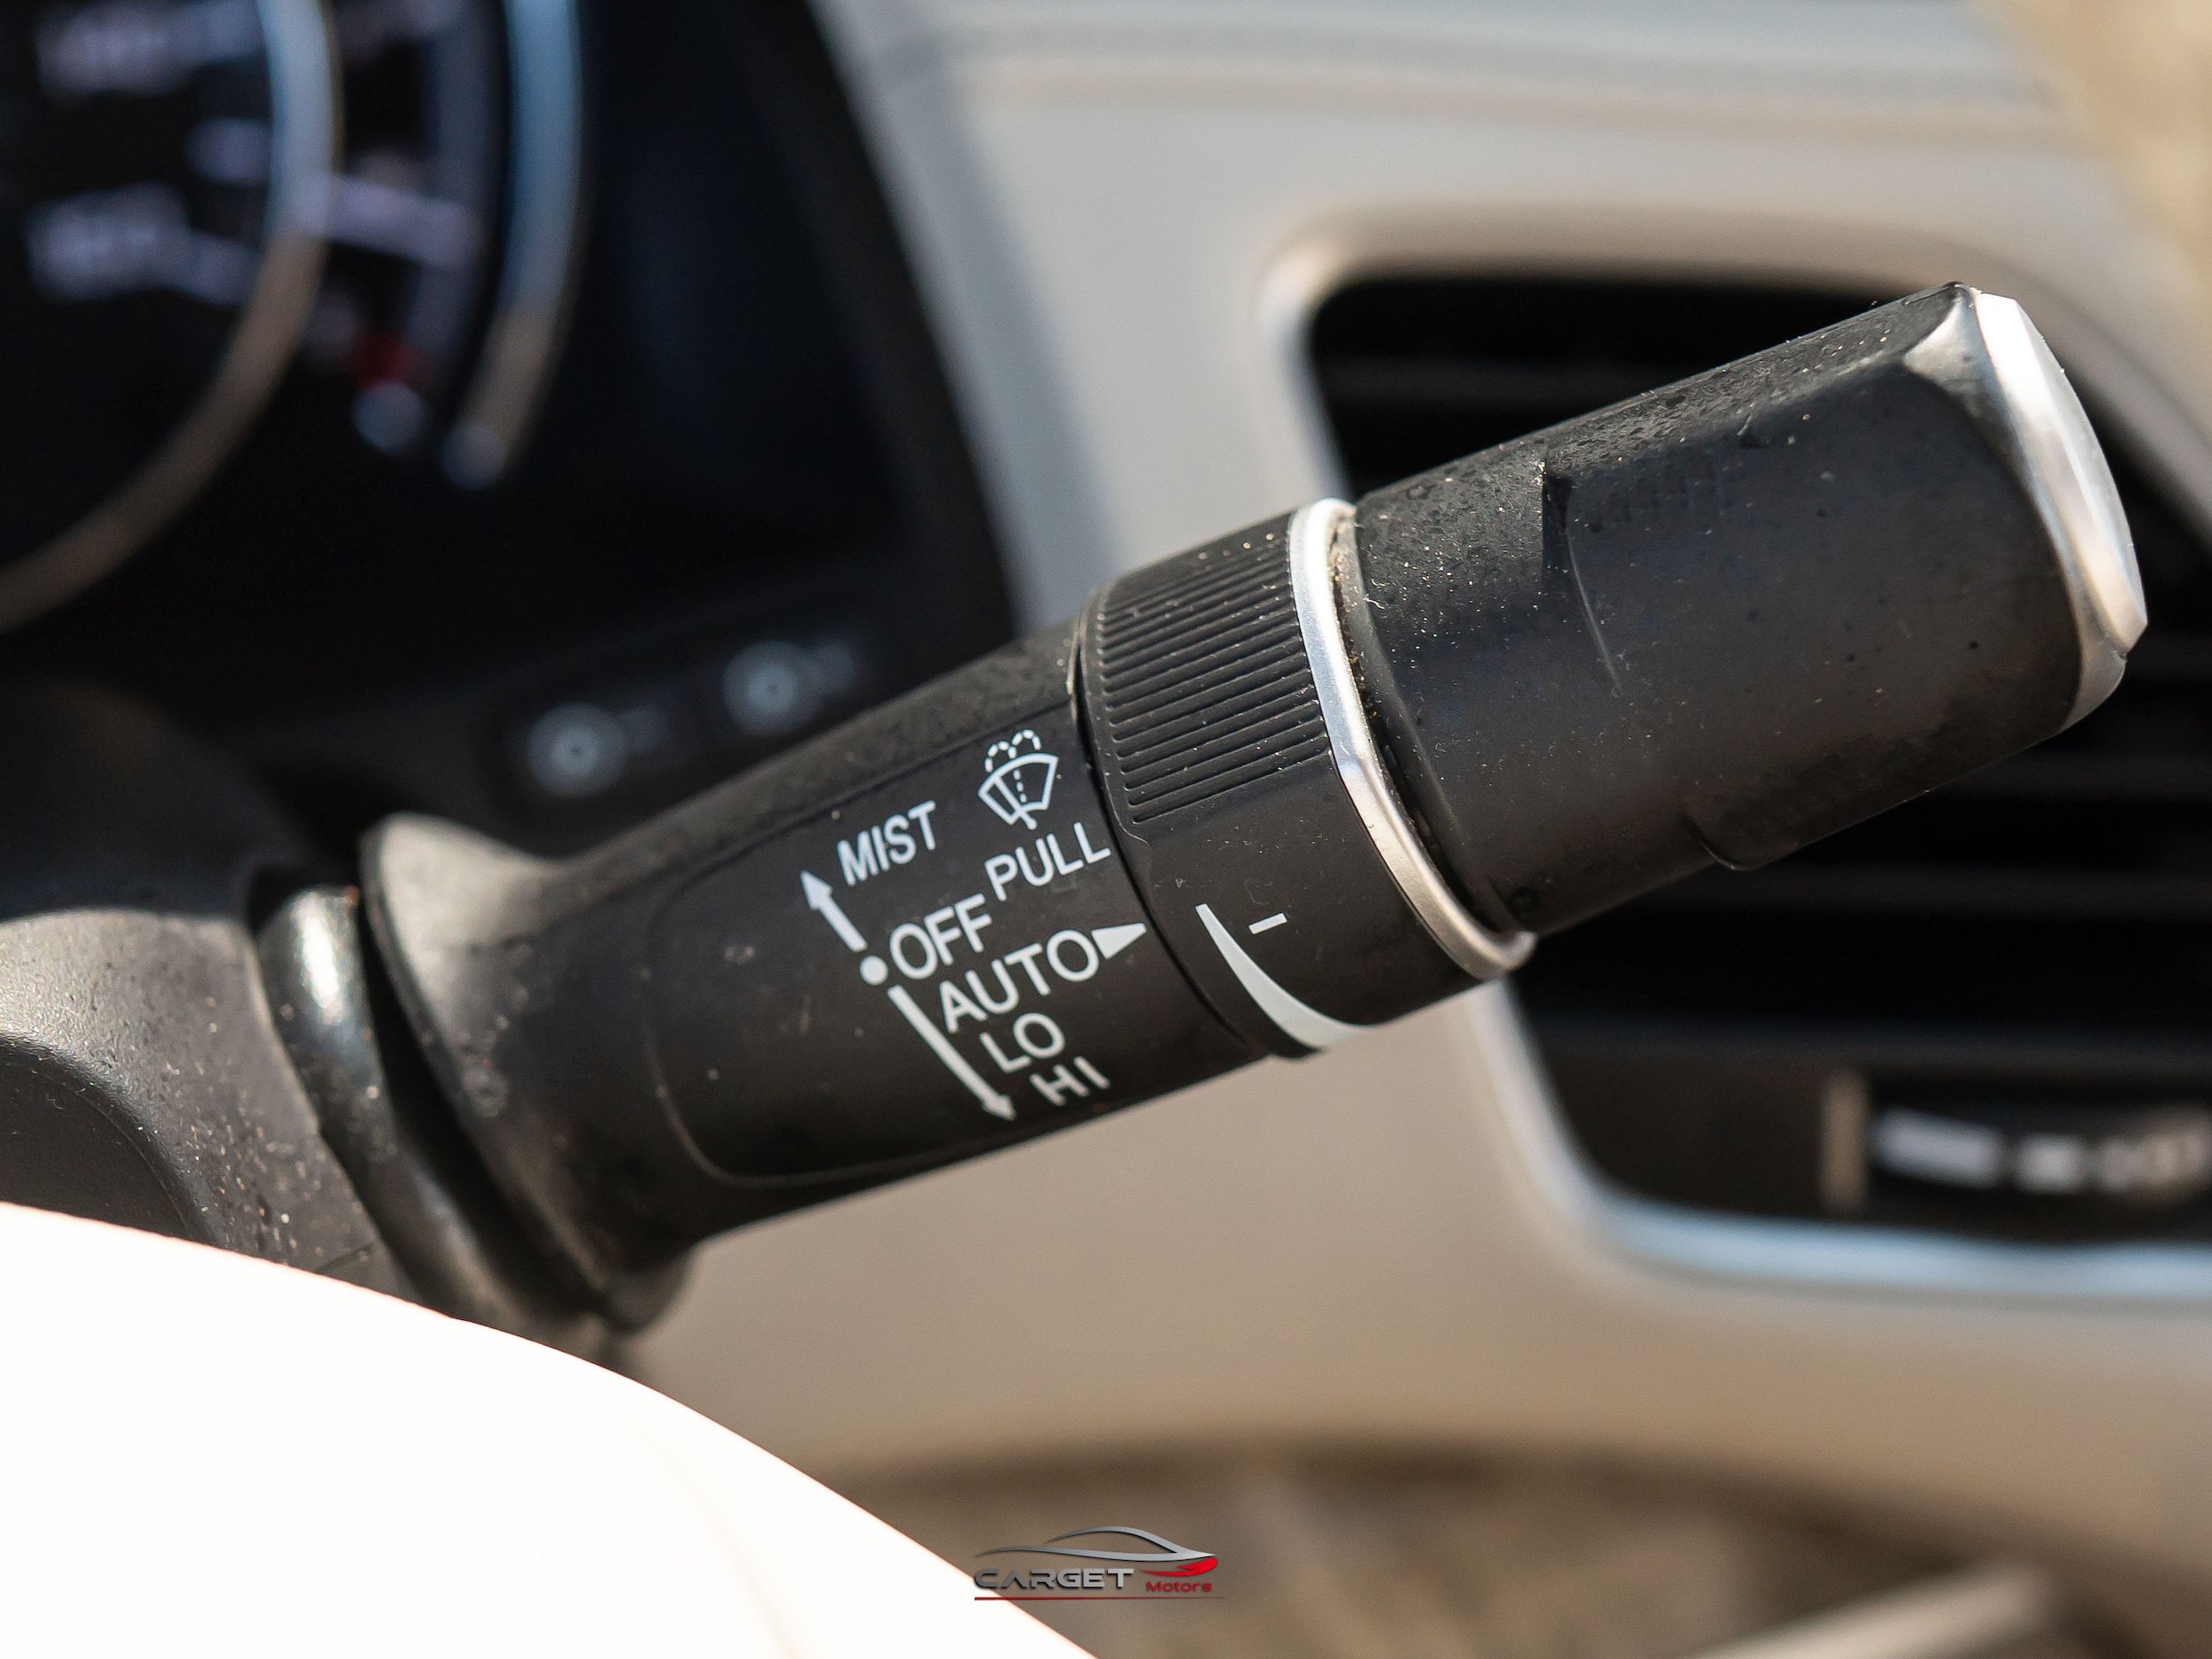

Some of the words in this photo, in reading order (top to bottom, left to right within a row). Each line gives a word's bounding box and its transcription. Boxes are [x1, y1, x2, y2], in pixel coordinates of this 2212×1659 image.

[837, 801, 936, 885] MIST
[985, 822, 1110, 901] PULL
[890, 894, 992, 979] OFF
[940, 929, 1099, 1033] AUTO
[980, 1013, 1064, 1073] LO
[1030, 1056, 1110, 1105] HI
